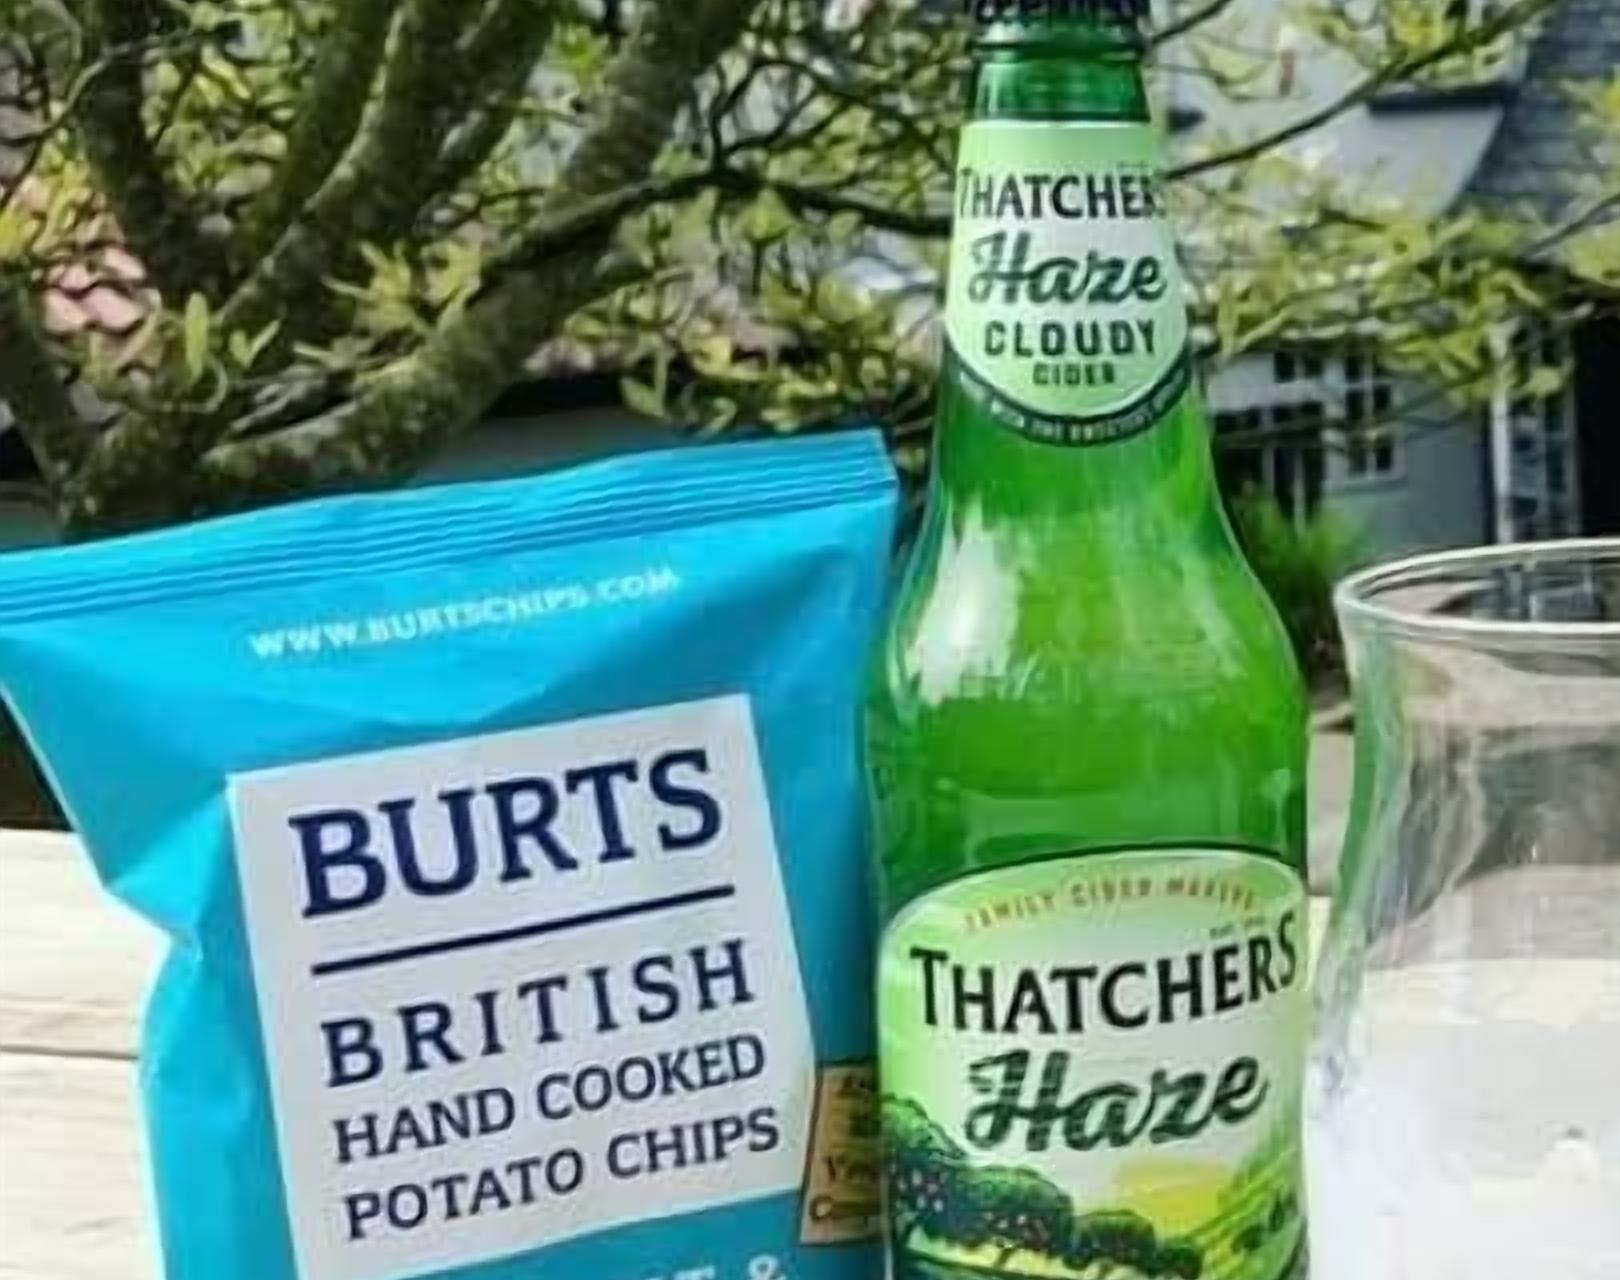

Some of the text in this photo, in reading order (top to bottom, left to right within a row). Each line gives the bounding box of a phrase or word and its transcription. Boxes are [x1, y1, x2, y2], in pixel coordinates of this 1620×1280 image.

[969, 231, 1168, 304] Haze
[984, 319, 1156, 358] CLOUDY
[1033, 363, 1116, 387] CIDER
[249, 566, 679, 658] WWW.BURTSCHIPS.COM
[288, 748, 723, 919] BURTS
[1071, 877, 1151, 907] CIDER
[320, 938, 756, 1087] BRITISH
[909, 910, 1297, 1034] THATCHERS
[335, 1033, 766, 1165] HAND COOKED
[964, 1050, 1270, 1153] Haze
[346, 1149, 584, 1241] POTATO
[606, 1106, 781, 1180] CHIPS
